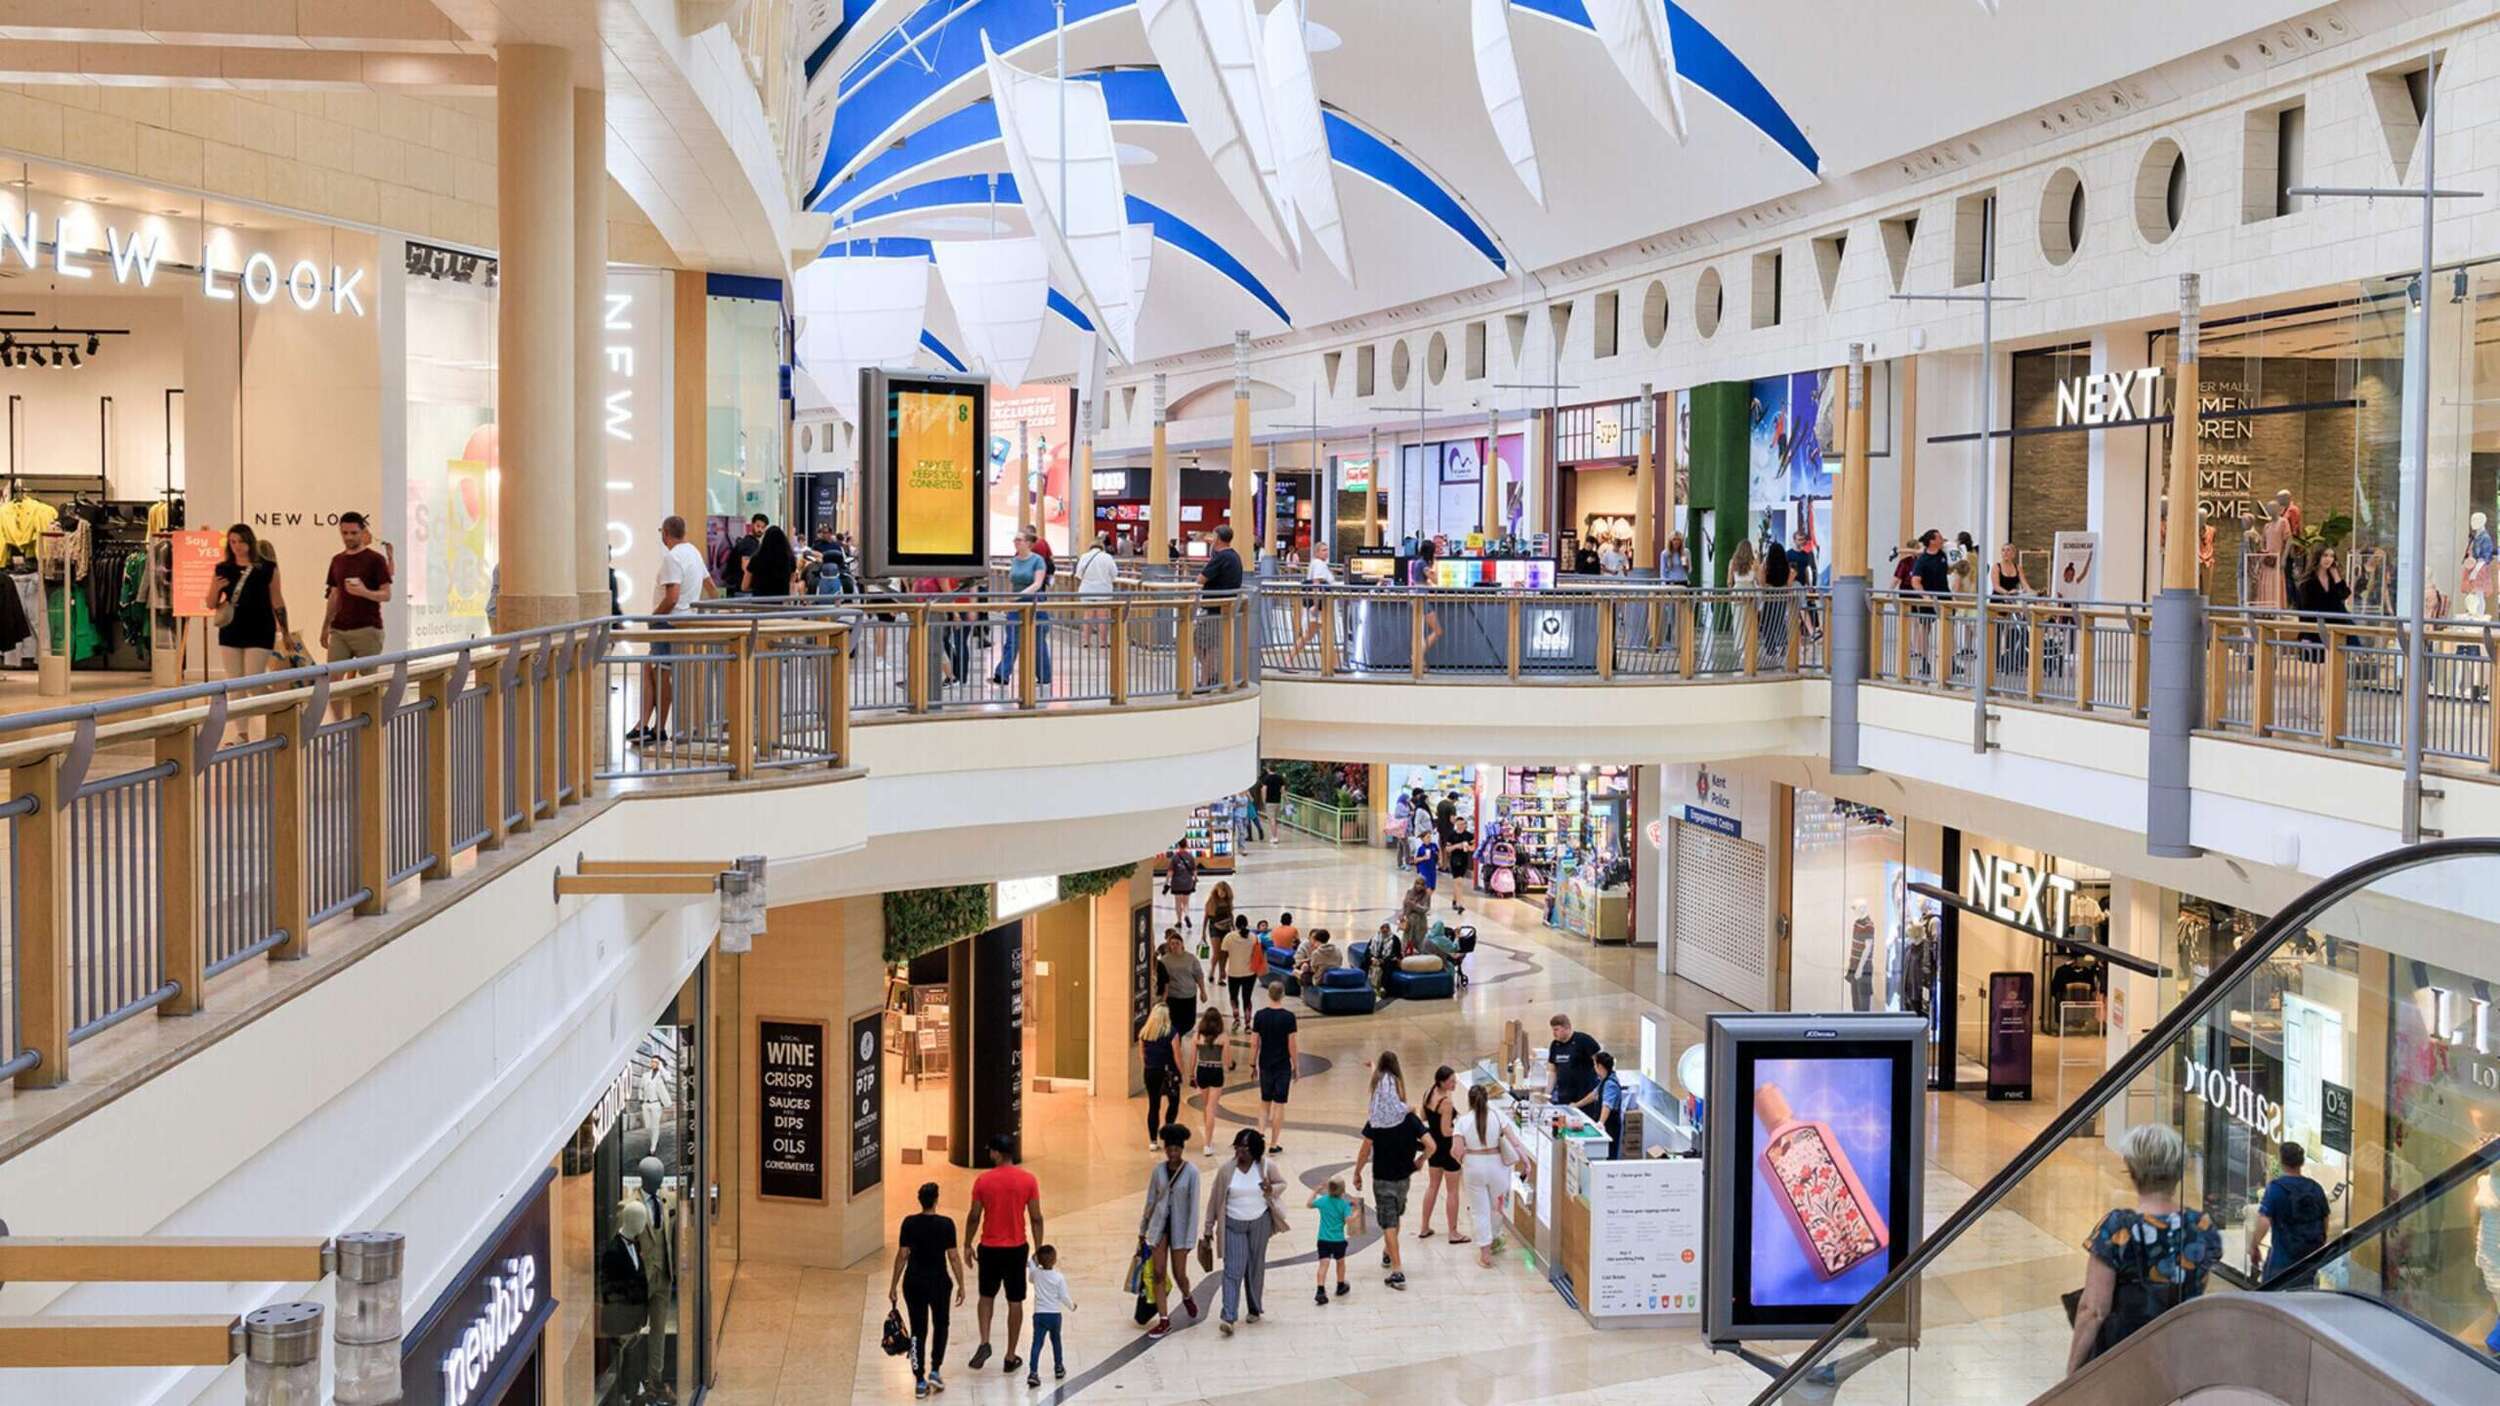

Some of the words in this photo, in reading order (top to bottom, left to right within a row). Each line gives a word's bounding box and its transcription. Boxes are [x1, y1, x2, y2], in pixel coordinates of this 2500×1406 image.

[0, 209, 160, 288] NEW
[202, 244, 365, 317] LOOK
[2219, 381, 2253, 392] MALL
[2055, 366, 2165, 428] NEXT
[2217, 453, 2250, 465] MALL
[908, 480, 964, 490] CONNECTED
[2198, 500, 2252, 519] OME
[255, 512, 302, 526] NEW
[184, 535, 209, 548] Say
[198, 547, 221, 558] YES
[1711, 774, 1727, 789] Kent
[1711, 792, 1730, 809] Police
[1966, 848, 2076, 939] NEXT
[766, 1041, 815, 1067] WINE
[764, 1071, 813, 1089] CRISPS
[768, 1096, 811, 1110] SAUCES
[774, 1115, 804, 1129] DIPS
[772, 1138, 806, 1154] OILS
[764, 1160, 816, 1173] CONDIMENTS
[442, 1254, 536, 1406] newbie
